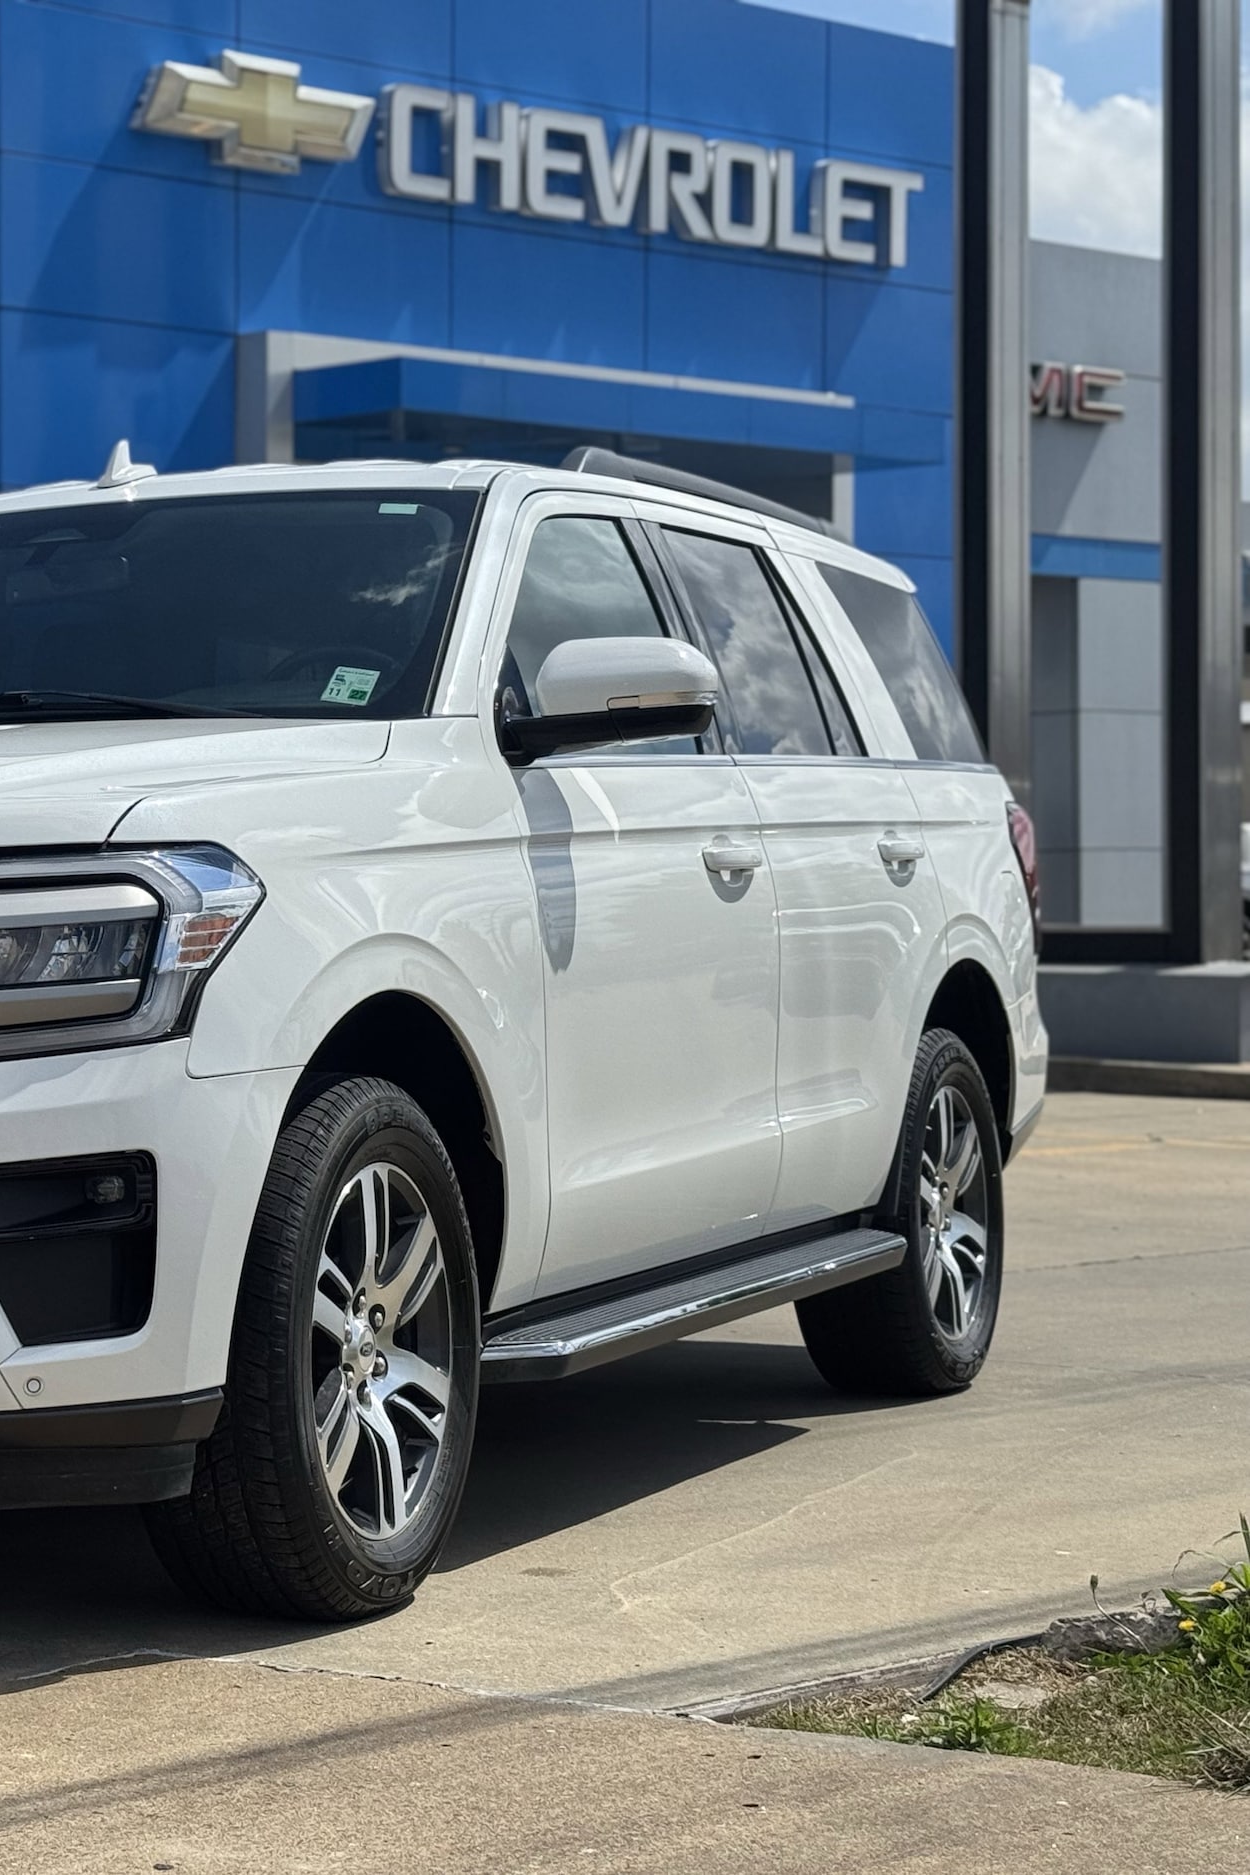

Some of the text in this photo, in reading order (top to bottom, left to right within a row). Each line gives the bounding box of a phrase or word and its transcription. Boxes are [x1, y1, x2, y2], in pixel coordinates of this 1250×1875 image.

[379, 83, 924, 268] CHEVROLET
[1030, 361, 1125, 421] MC
[328, 687, 341, 697] 11
[350, 689, 367, 700] 27
